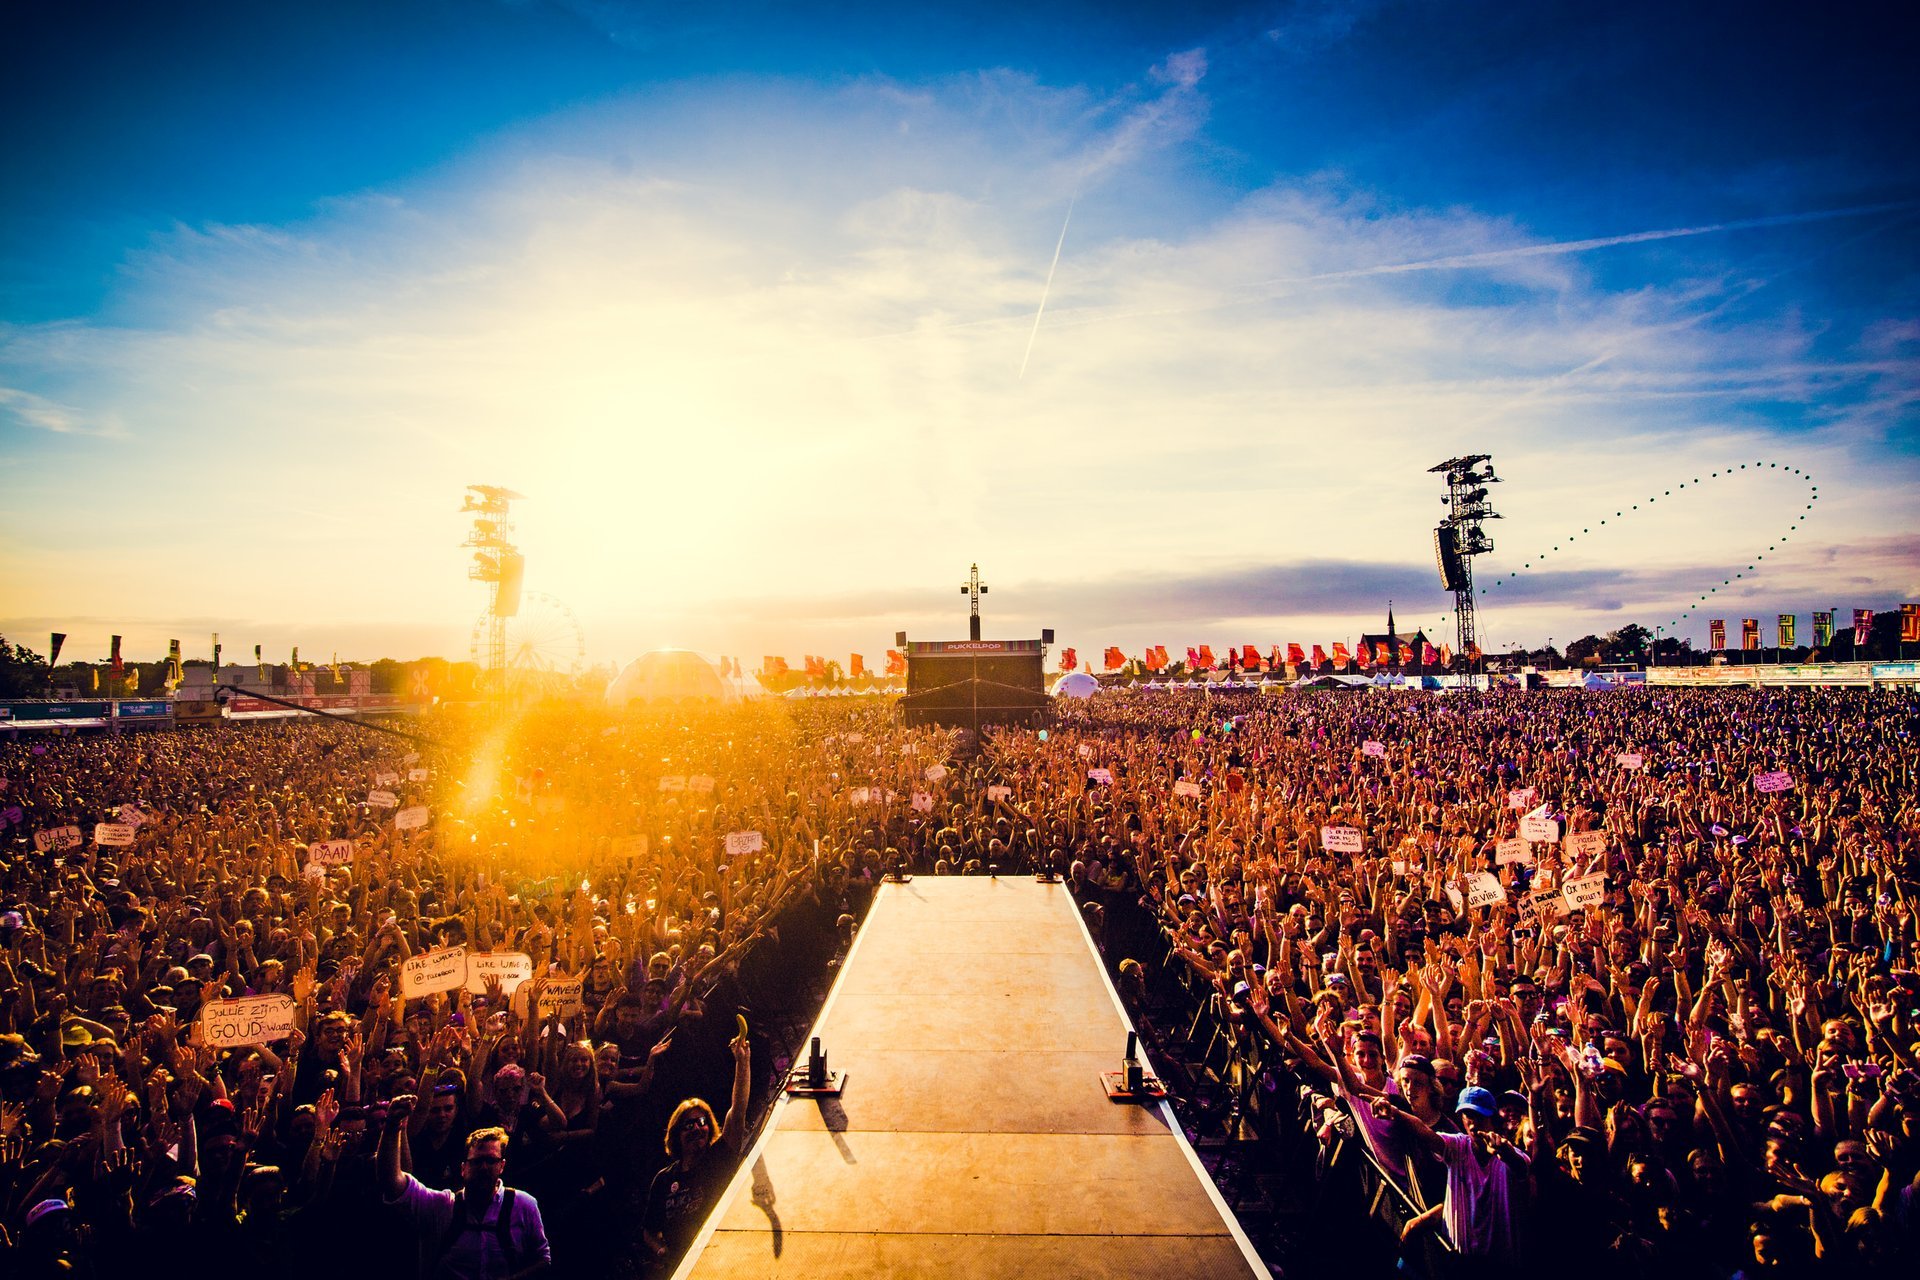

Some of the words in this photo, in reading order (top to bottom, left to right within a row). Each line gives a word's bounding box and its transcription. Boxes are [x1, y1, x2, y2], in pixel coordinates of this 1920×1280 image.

[730, 834, 761, 848] BAZART
[314, 844, 350, 861] DAAN
[1480, 890, 1499, 901] VIBE
[546, 984, 581, 996] WAVE-B
[210, 1021, 262, 1039] GOUD
